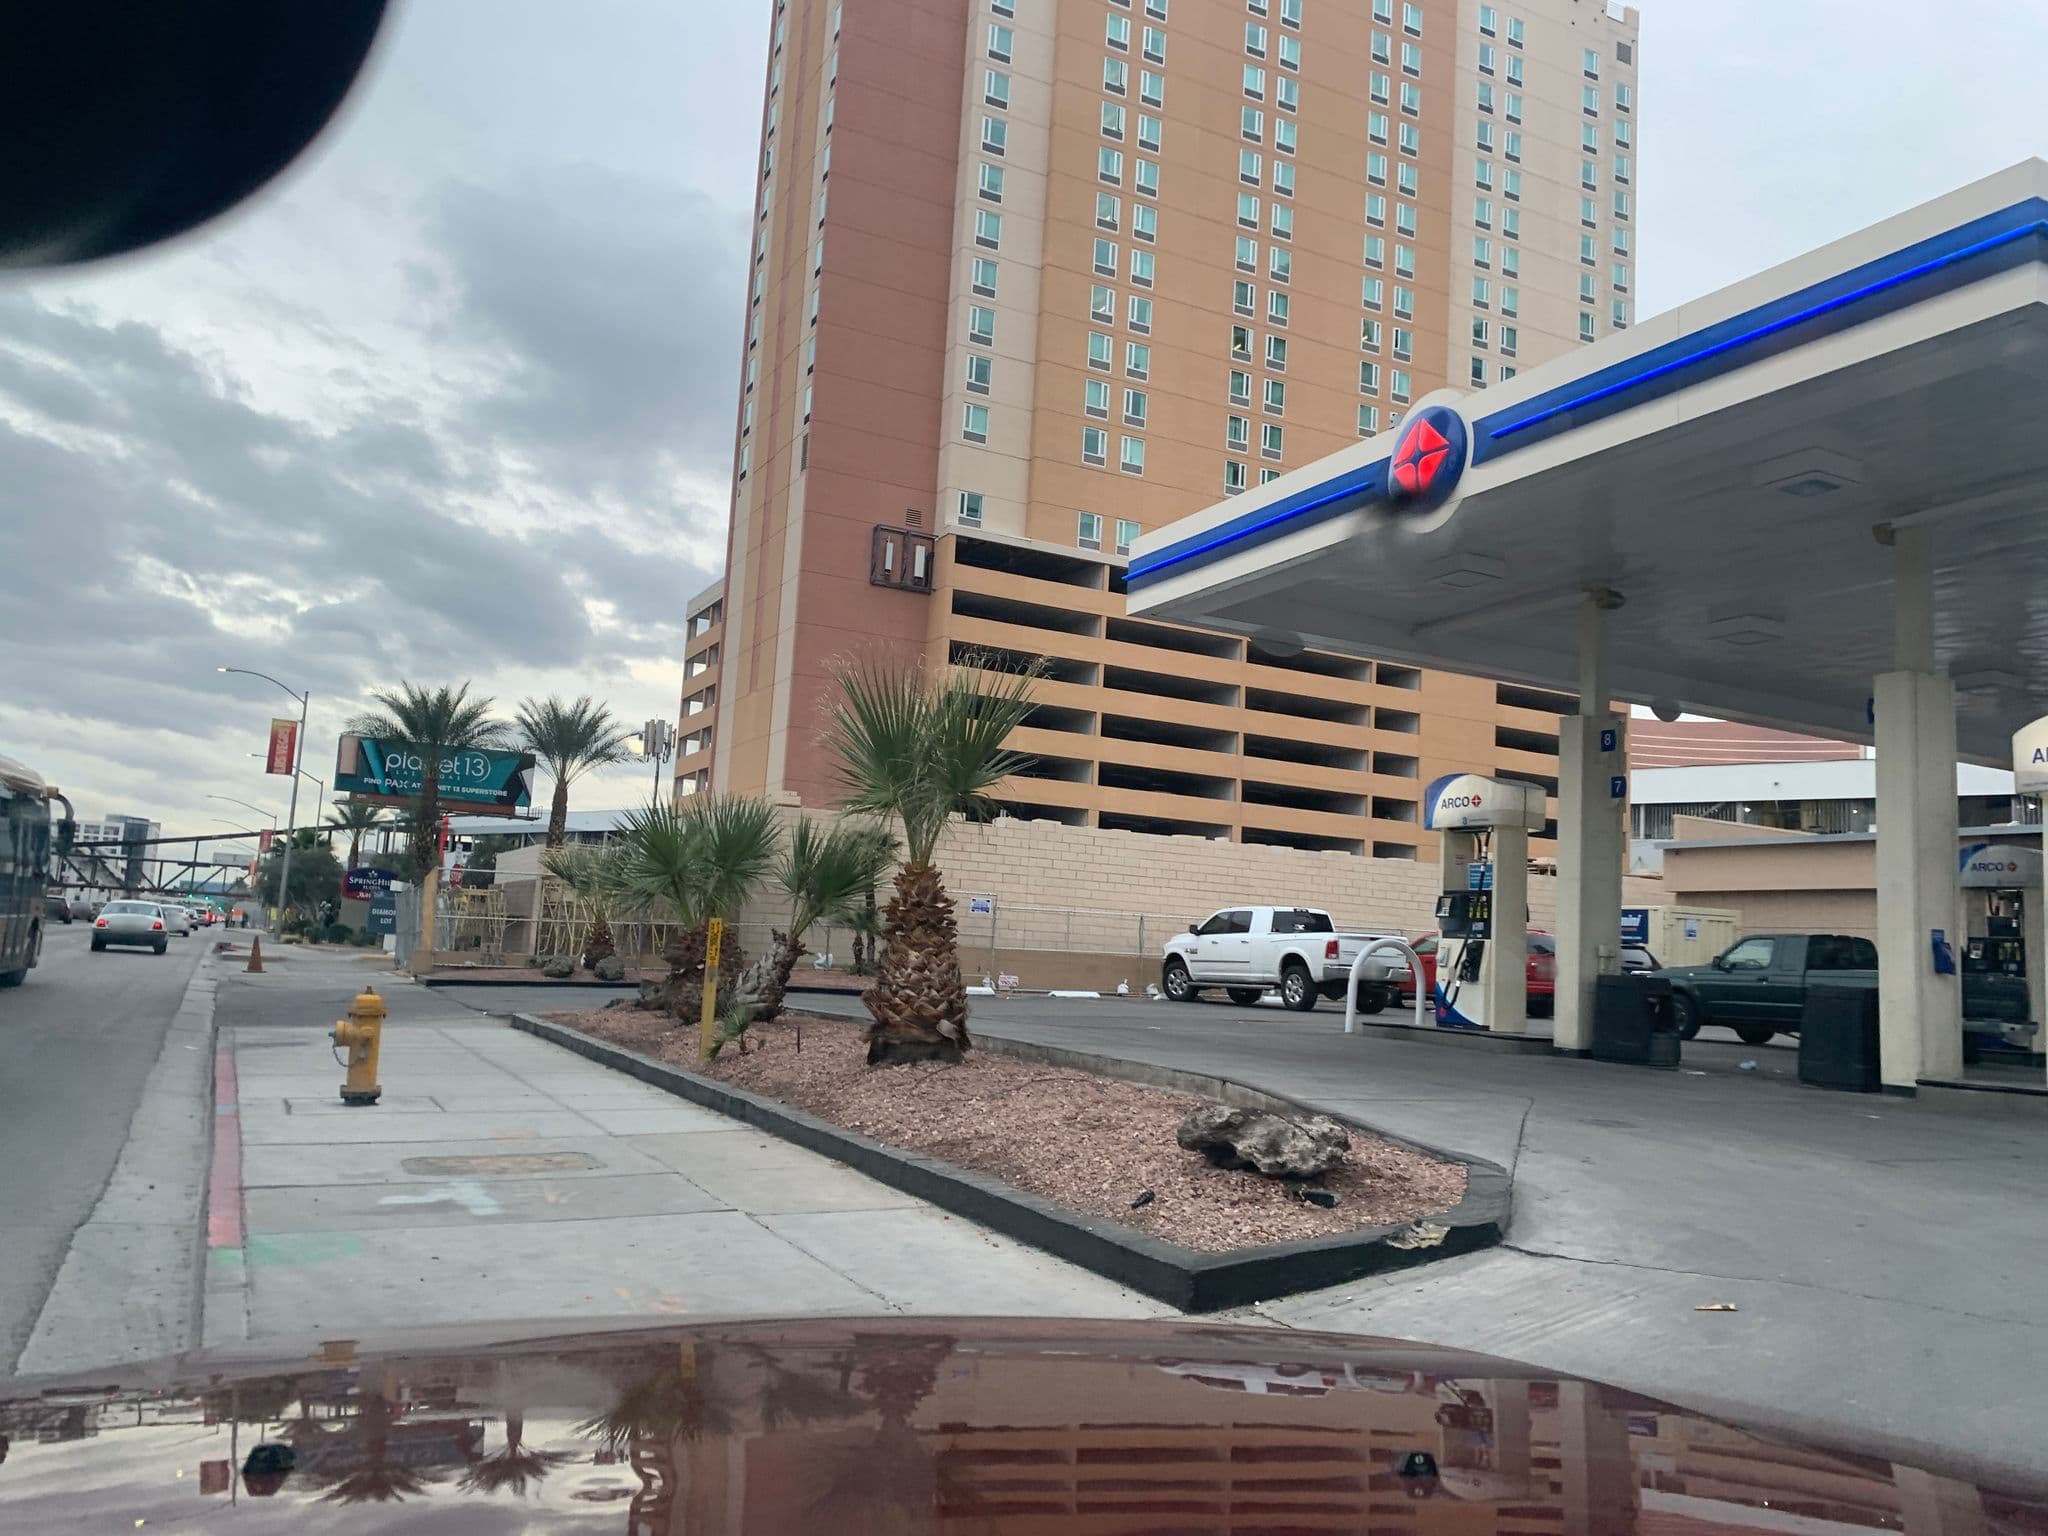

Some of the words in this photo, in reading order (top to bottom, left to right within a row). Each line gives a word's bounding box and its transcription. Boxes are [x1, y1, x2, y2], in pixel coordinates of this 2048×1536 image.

[1604, 733, 1611, 746] 8
[465, 757, 485, 777] 13
[363, 777, 382, 785] FIND
[384, 777, 408, 789] PAX
[461, 786, 508, 797] SUPERSTORE
[1614, 780, 1622, 793] 7
[1441, 796, 1470, 809] ARCO
[1970, 862, 2004, 872] ARCO
